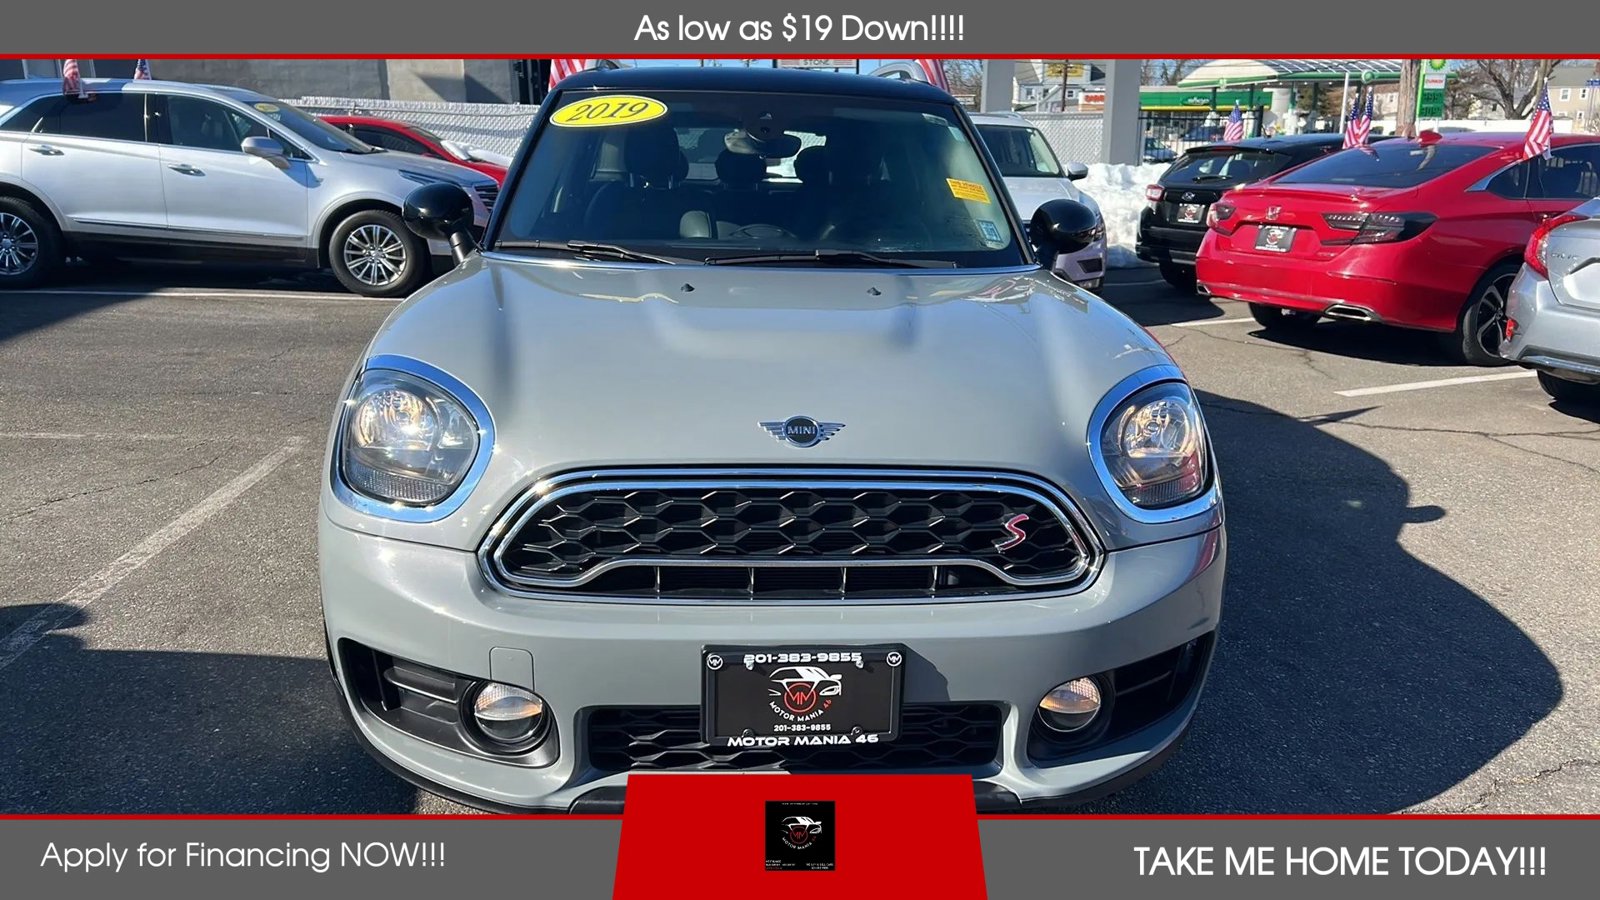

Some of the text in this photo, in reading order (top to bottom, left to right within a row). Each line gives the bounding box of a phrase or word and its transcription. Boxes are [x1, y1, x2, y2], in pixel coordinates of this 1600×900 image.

[565, 101, 649, 122] 2019
[787, 426, 816, 435] MINI
[994, 513, 1030, 551] S
[743, 652, 863, 665] 201-383-9855
[769, 701, 795, 722] MOTOR
[797, 709, 824, 722] MANIA
[773, 723, 832, 732] 201-383-9855
[727, 733, 879, 747] MOTOR MANIA 46
